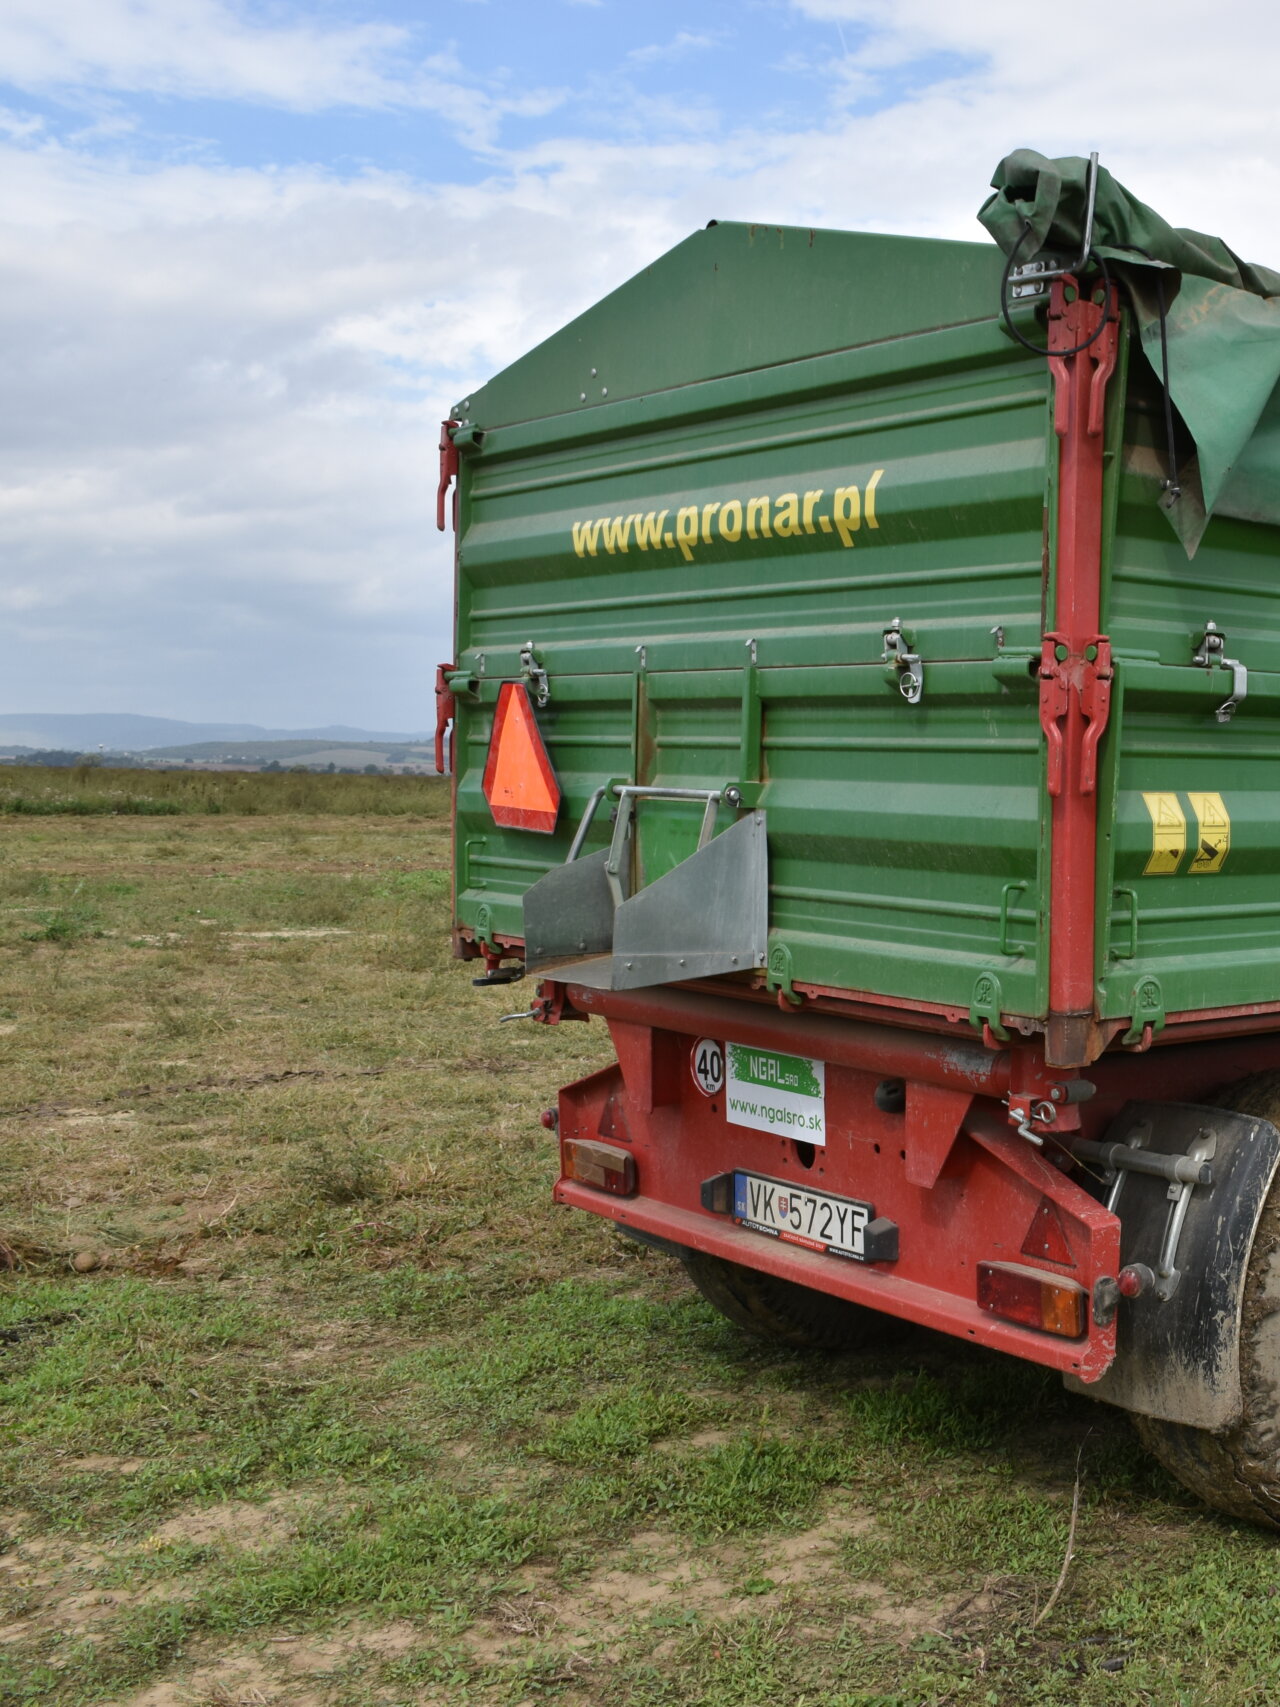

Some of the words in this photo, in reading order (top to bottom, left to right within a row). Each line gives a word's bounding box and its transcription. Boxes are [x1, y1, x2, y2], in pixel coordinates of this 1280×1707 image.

[572, 469, 884, 561] www.pronar.pl
[697, 1049, 722, 1083] 40
[749, 1055, 785, 1084] NGAL
[705, 1081, 716, 1092] km
[729, 1097, 822, 1131] www.ngalsro.sk
[750, 1181, 776, 1223] VK
[789, 1193, 865, 1247] 572YF
